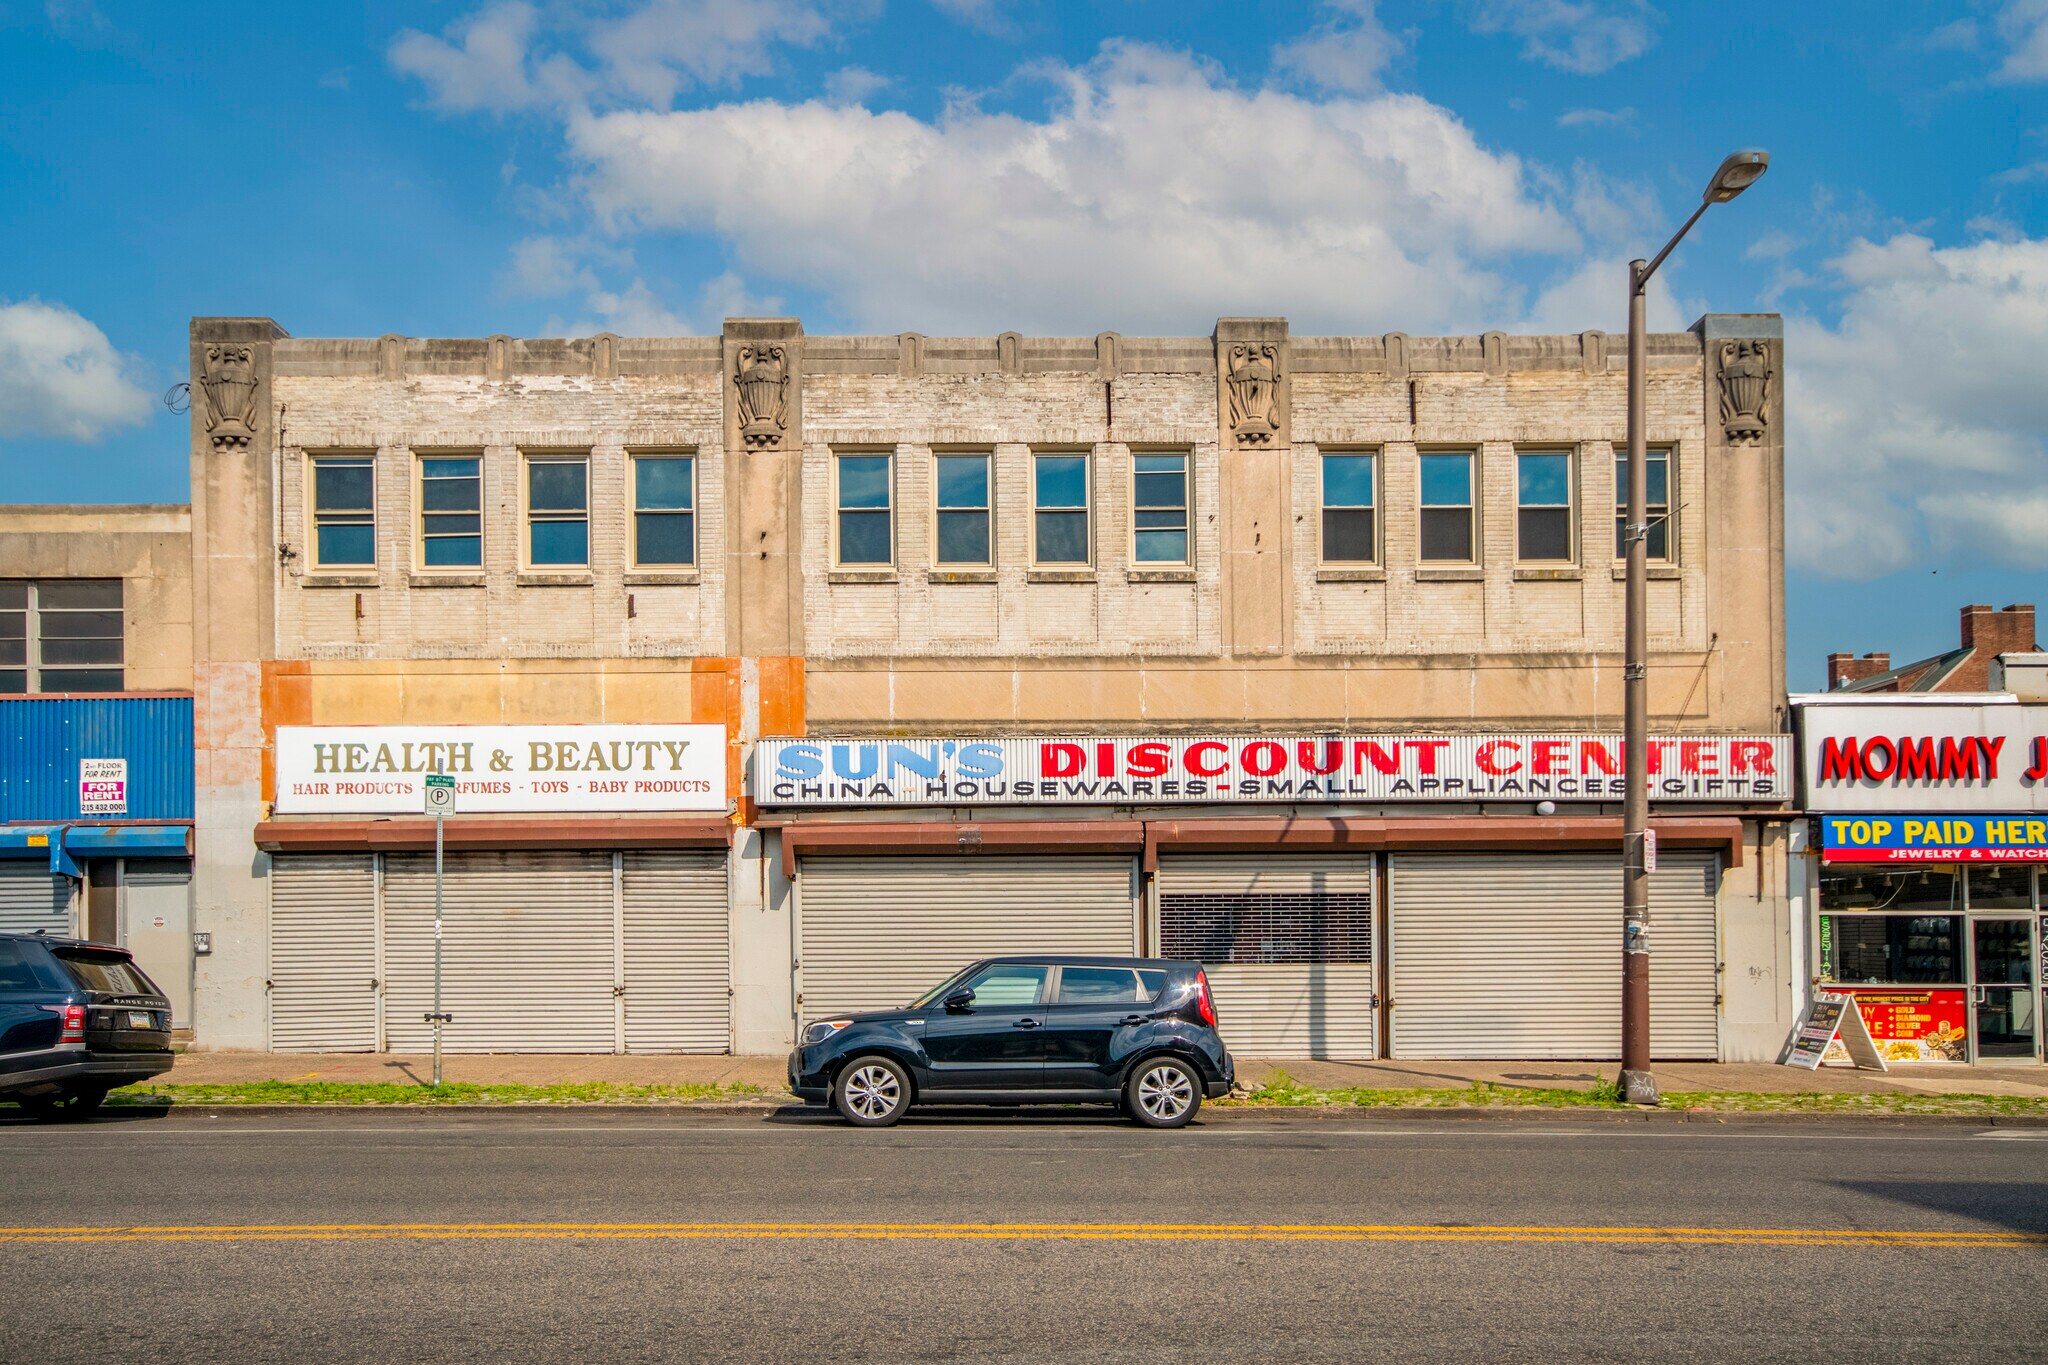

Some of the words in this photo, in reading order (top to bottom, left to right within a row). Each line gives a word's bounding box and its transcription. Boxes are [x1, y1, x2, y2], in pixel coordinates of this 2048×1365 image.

[313, 742, 474, 773] HEALTH
[489, 749, 514, 772] &
[527, 741, 690, 772] BEAUTY
[775, 741, 1004, 780] SUN'S
[1041, 740, 1450, 778] DISCOUNT
[1475, 740, 1777, 776] CENTER
[1822, 735, 2005, 781] MOMMY
[88, 783, 117, 791] FOR
[293, 783, 329, 795] HAIR
[335, 782, 413, 795] PRODUCTS
[455, 781, 511, 794] RFUMES
[531, 781, 569, 793] TOYS
[589, 781, 628, 793] BABY
[634, 780, 711, 793] PRODUCTS
[773, 782, 894, 798] CHINA
[926, 781, 1207, 798] HOUSEWARES
[1239, 779, 1367, 795] SMALL
[1390, 778, 1625, 794] APPLIANCES
[1662, 778, 1774, 794] GIFTS
[83, 791, 122, 800] RENT
[1831, 820, 1892, 844] TOP
[1903, 820, 1974, 844] PAID
[1985, 820, 2048, 843] HER
[1888, 849, 1963, 859] JEWELRY
[1970, 849, 1982, 858] &
[1989, 849, 2048, 858] WATCH
[1858, 1006, 1876, 1019] UY
[1895, 1006, 1915, 1014] GOLD
[1895, 1014, 1931, 1022] DIAMOND
[1895, 1022, 1921, 1030] SILVER
